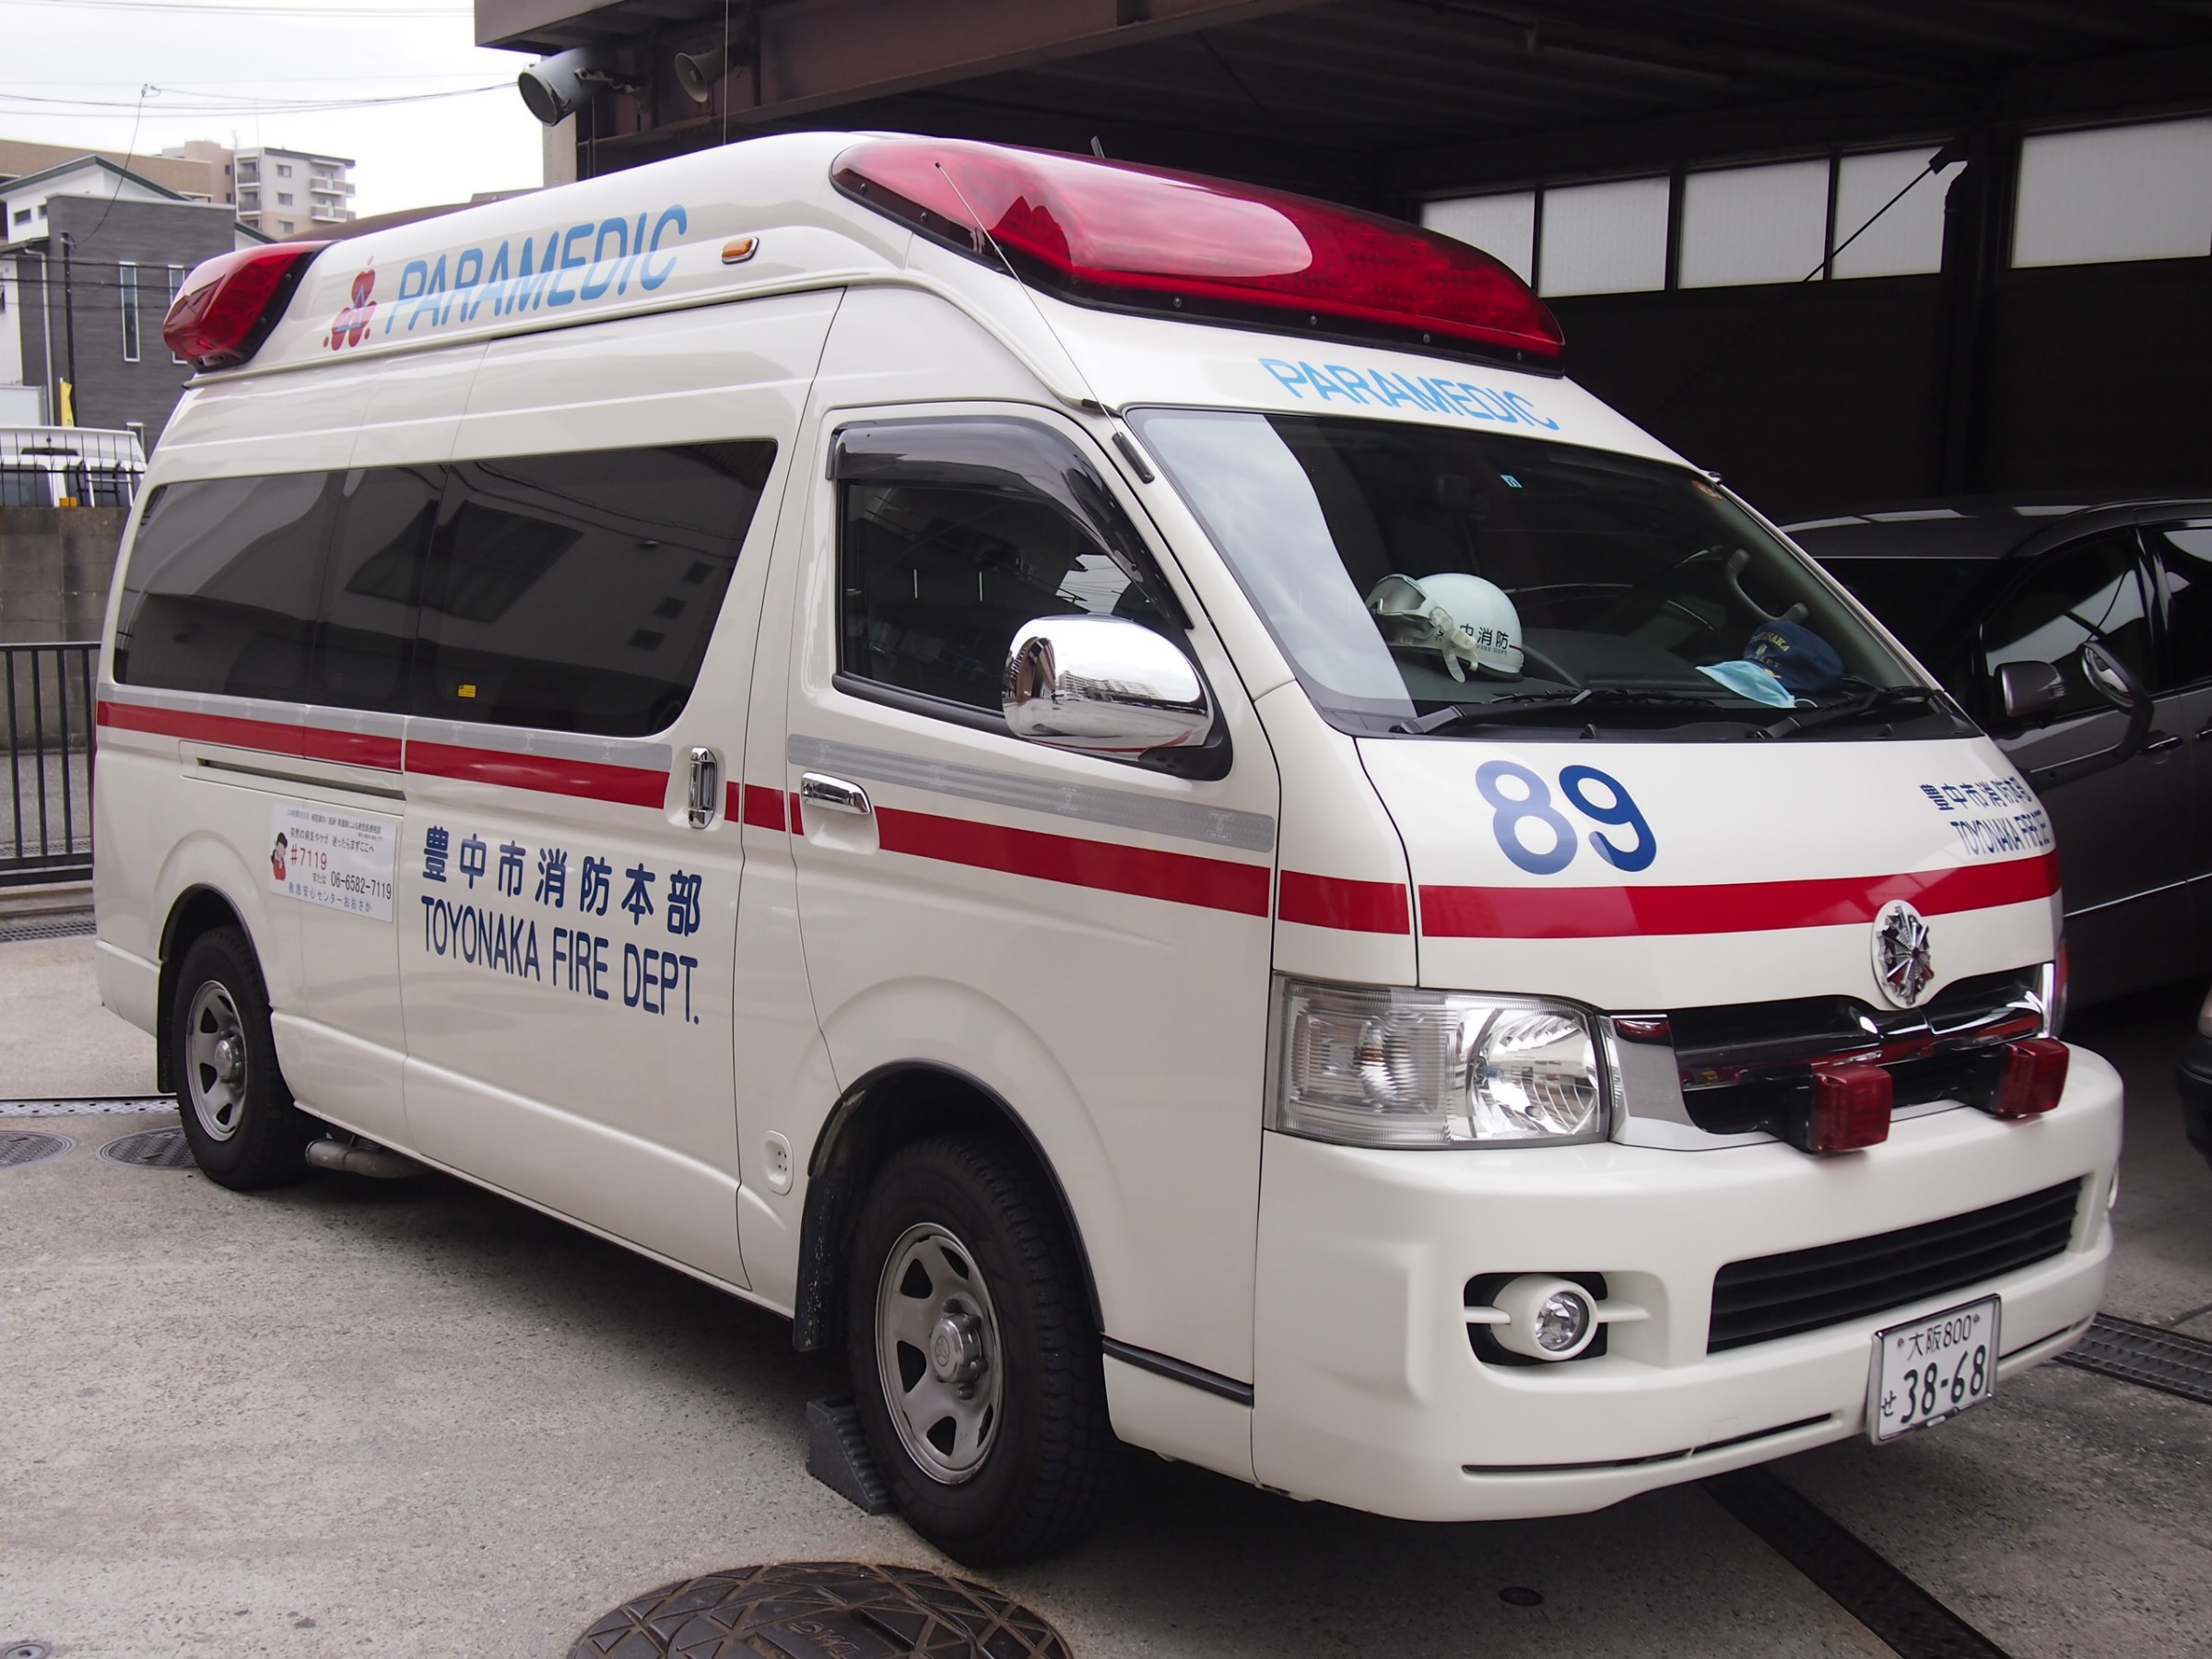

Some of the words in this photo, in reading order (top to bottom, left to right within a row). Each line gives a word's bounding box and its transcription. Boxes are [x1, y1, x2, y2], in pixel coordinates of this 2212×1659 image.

[385, 204, 688, 335] PARAMEDIC
[1257, 358, 1560, 431] PARAMEDIC
[1438, 623, 1509, 650] 中消防
[1475, 759, 1657, 876] 89
[1950, 817, 2025, 855] TOYONAKA
[290, 843, 327, 870] #7119
[330, 870, 392, 900] 06-6582-7119
[422, 825, 702, 937] 豊中市消防本部
[421, 895, 541, 982] TOYONAKA
[553, 926, 609, 1000] FIRE
[623, 942, 700, 1025] DEPT.
[1881, 1390, 1897, 1418] せ
[1900, 1344, 1986, 1424] 38-68
